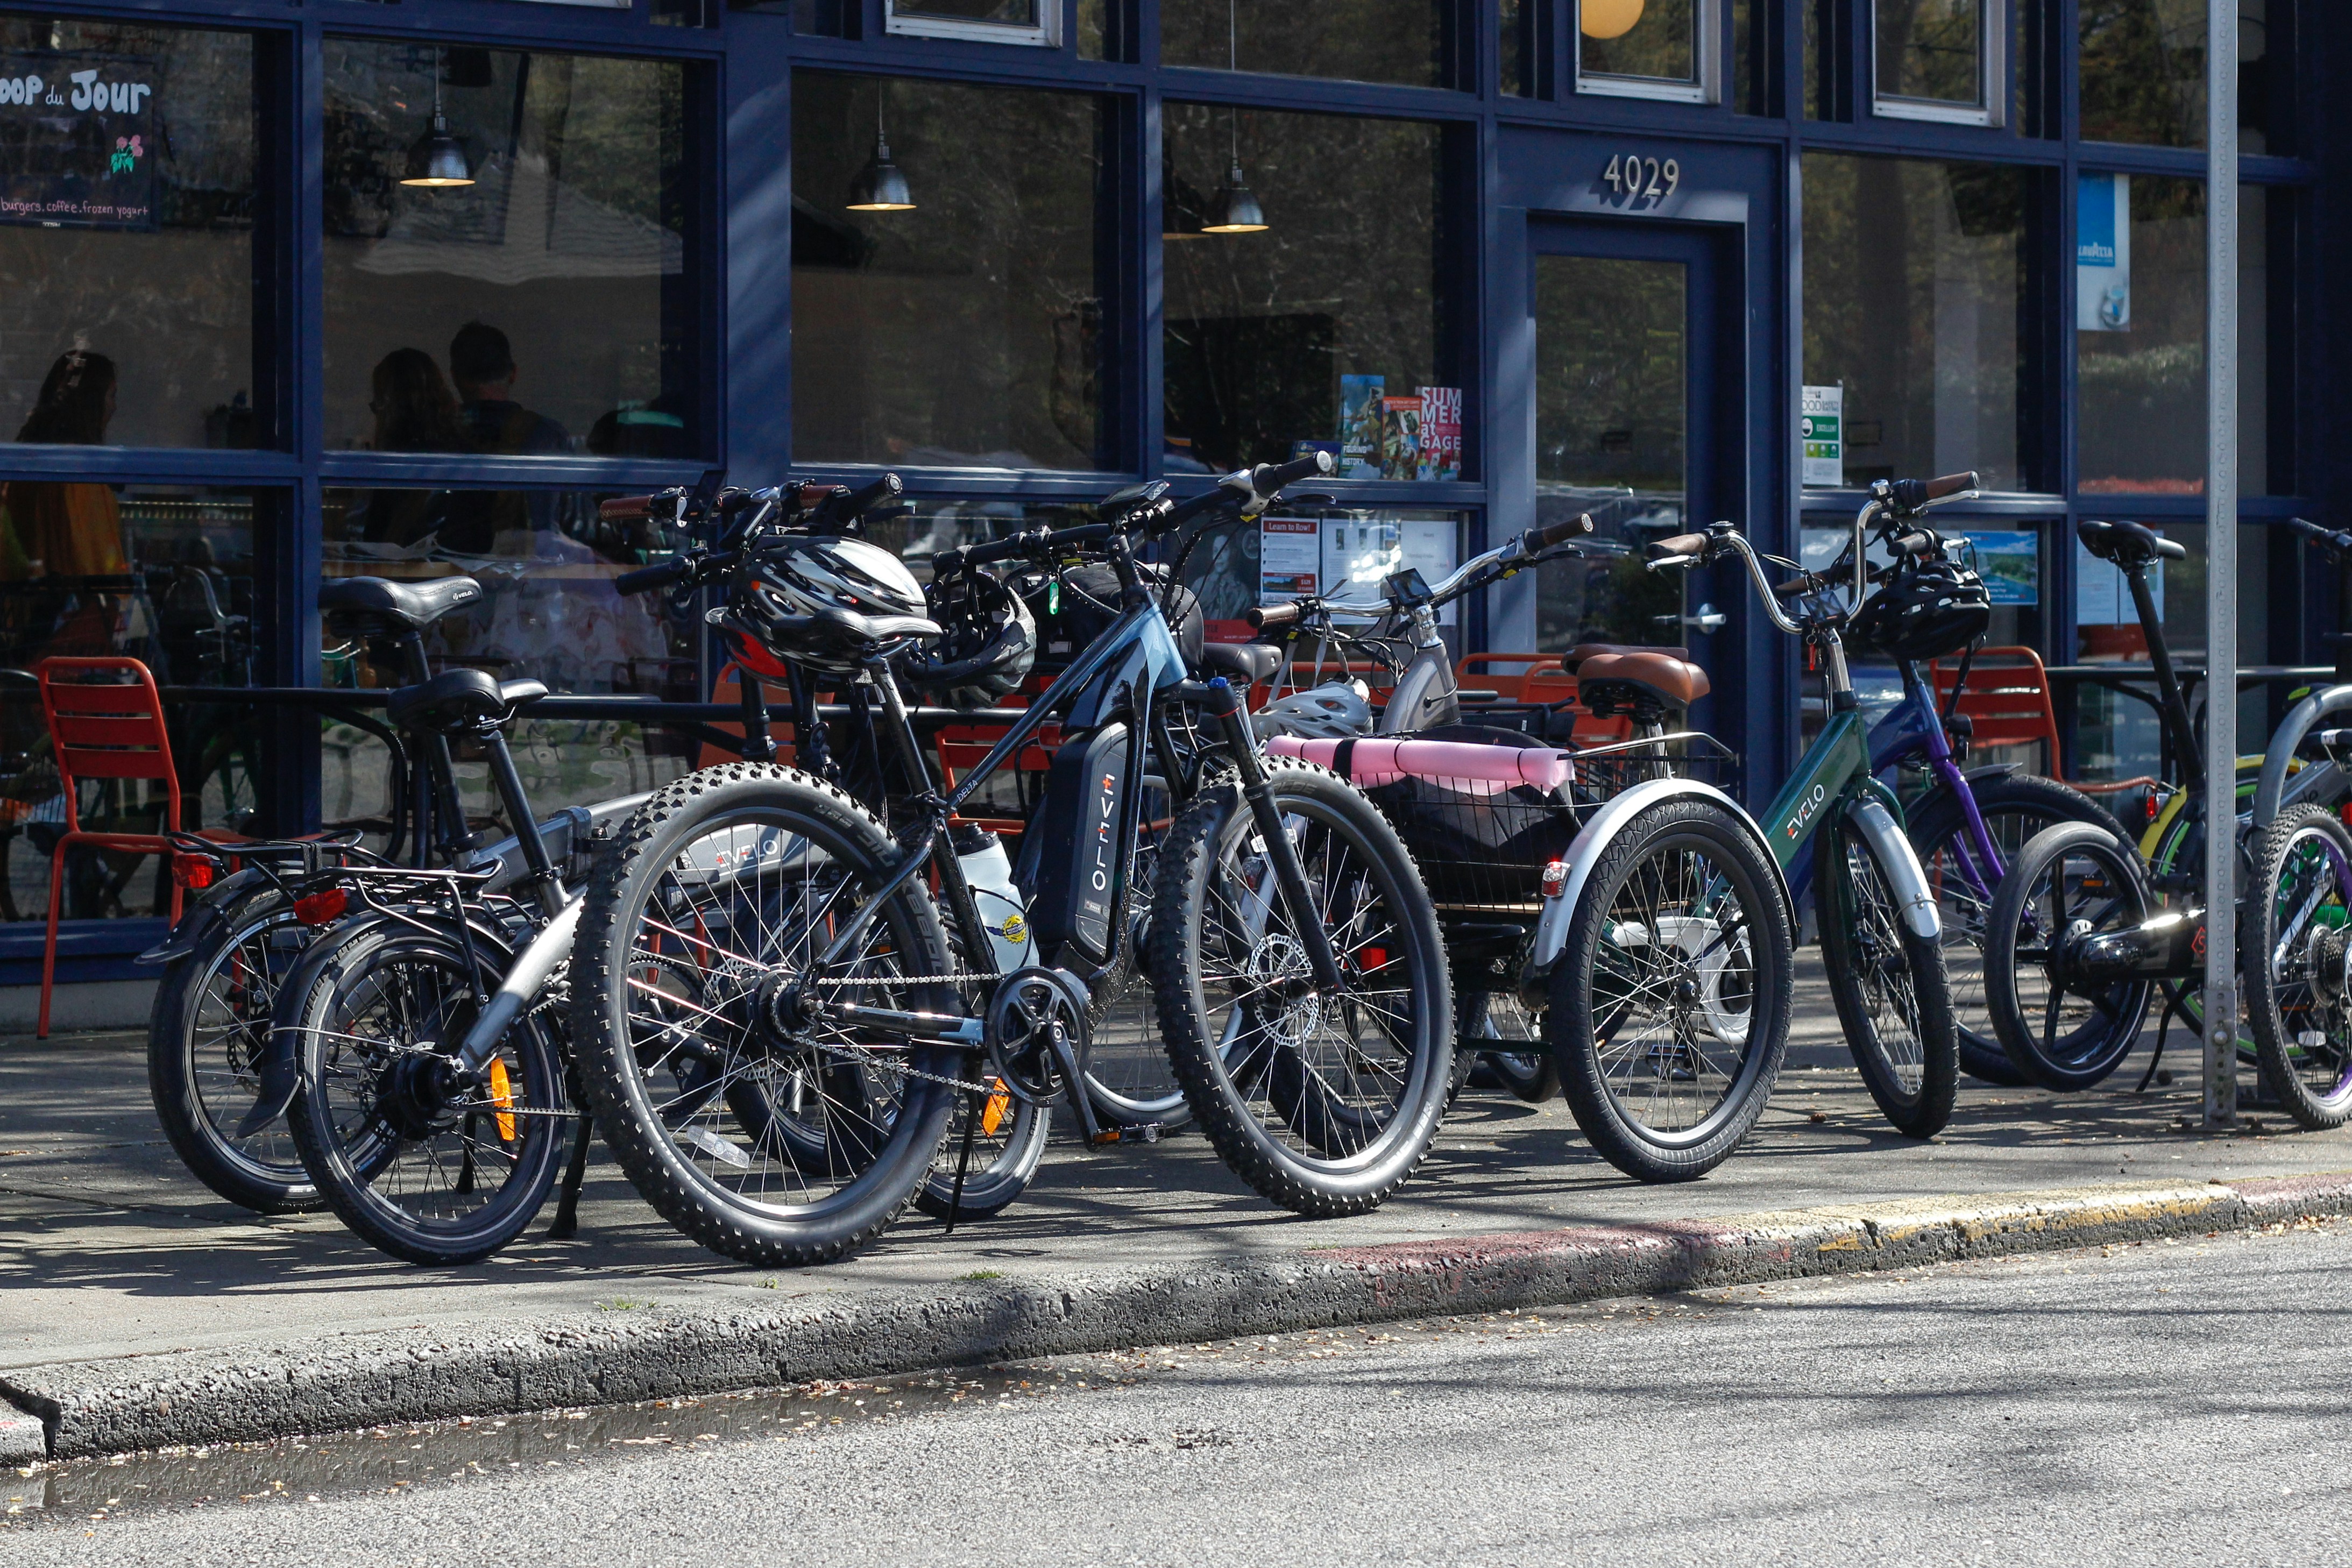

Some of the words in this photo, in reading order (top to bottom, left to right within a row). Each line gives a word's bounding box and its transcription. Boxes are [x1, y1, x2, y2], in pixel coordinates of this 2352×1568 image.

[46, 84, 64, 105] du
[70, 69, 151, 114] Jour
[1604, 154, 1680, 196] 4029
[116, 206, 148, 219] yogurt
[1421, 386, 1462, 407] SUM
[1802, 400, 1822, 411] OOD
[1421, 404, 1462, 424] MER
[1421, 421, 1436, 436] at
[1419, 434, 1462, 450] GAGE
[1342, 457, 1365, 465] HISTORY
[1269, 522, 1287, 530] Learn
[1295, 523, 1310, 531] Row!
[957, 779, 978, 802] DELTA
[1787, 784, 1825, 840] EVELO
[1092, 774, 1115, 891] EVELO
[715, 839, 778, 868] EVELO
